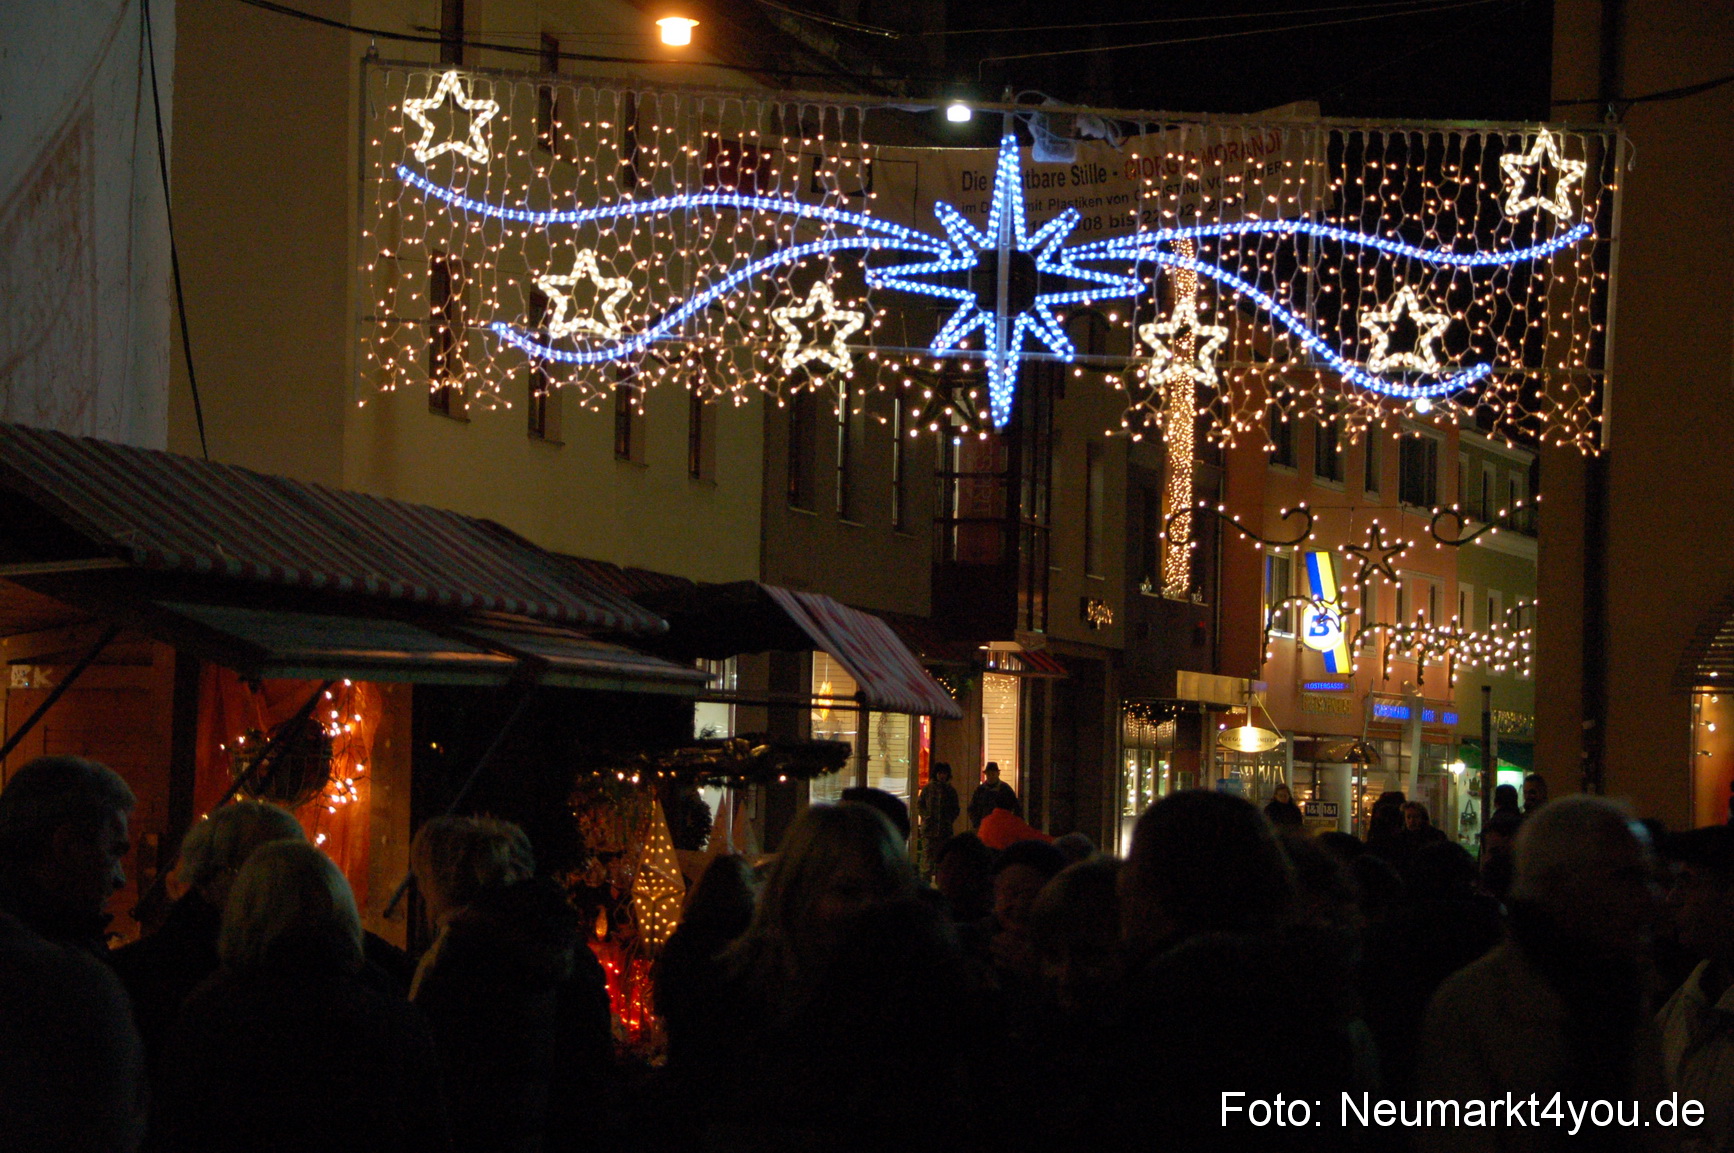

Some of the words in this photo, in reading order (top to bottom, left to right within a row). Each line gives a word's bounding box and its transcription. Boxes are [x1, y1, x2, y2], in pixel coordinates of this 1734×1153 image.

[962, 171, 988, 191] Die
[993, 166, 1066, 190] tbare
[1071, 162, 1108, 187] Stille
[1124, 150, 1196, 181] GIORGO
[962, 204, 977, 213] im
[1048, 195, 1103, 211] Plastiken
[1106, 194, 1129, 206] von
[1134, 180, 1205, 202] CHISTINA
[1110, 211, 1136, 228] bis
